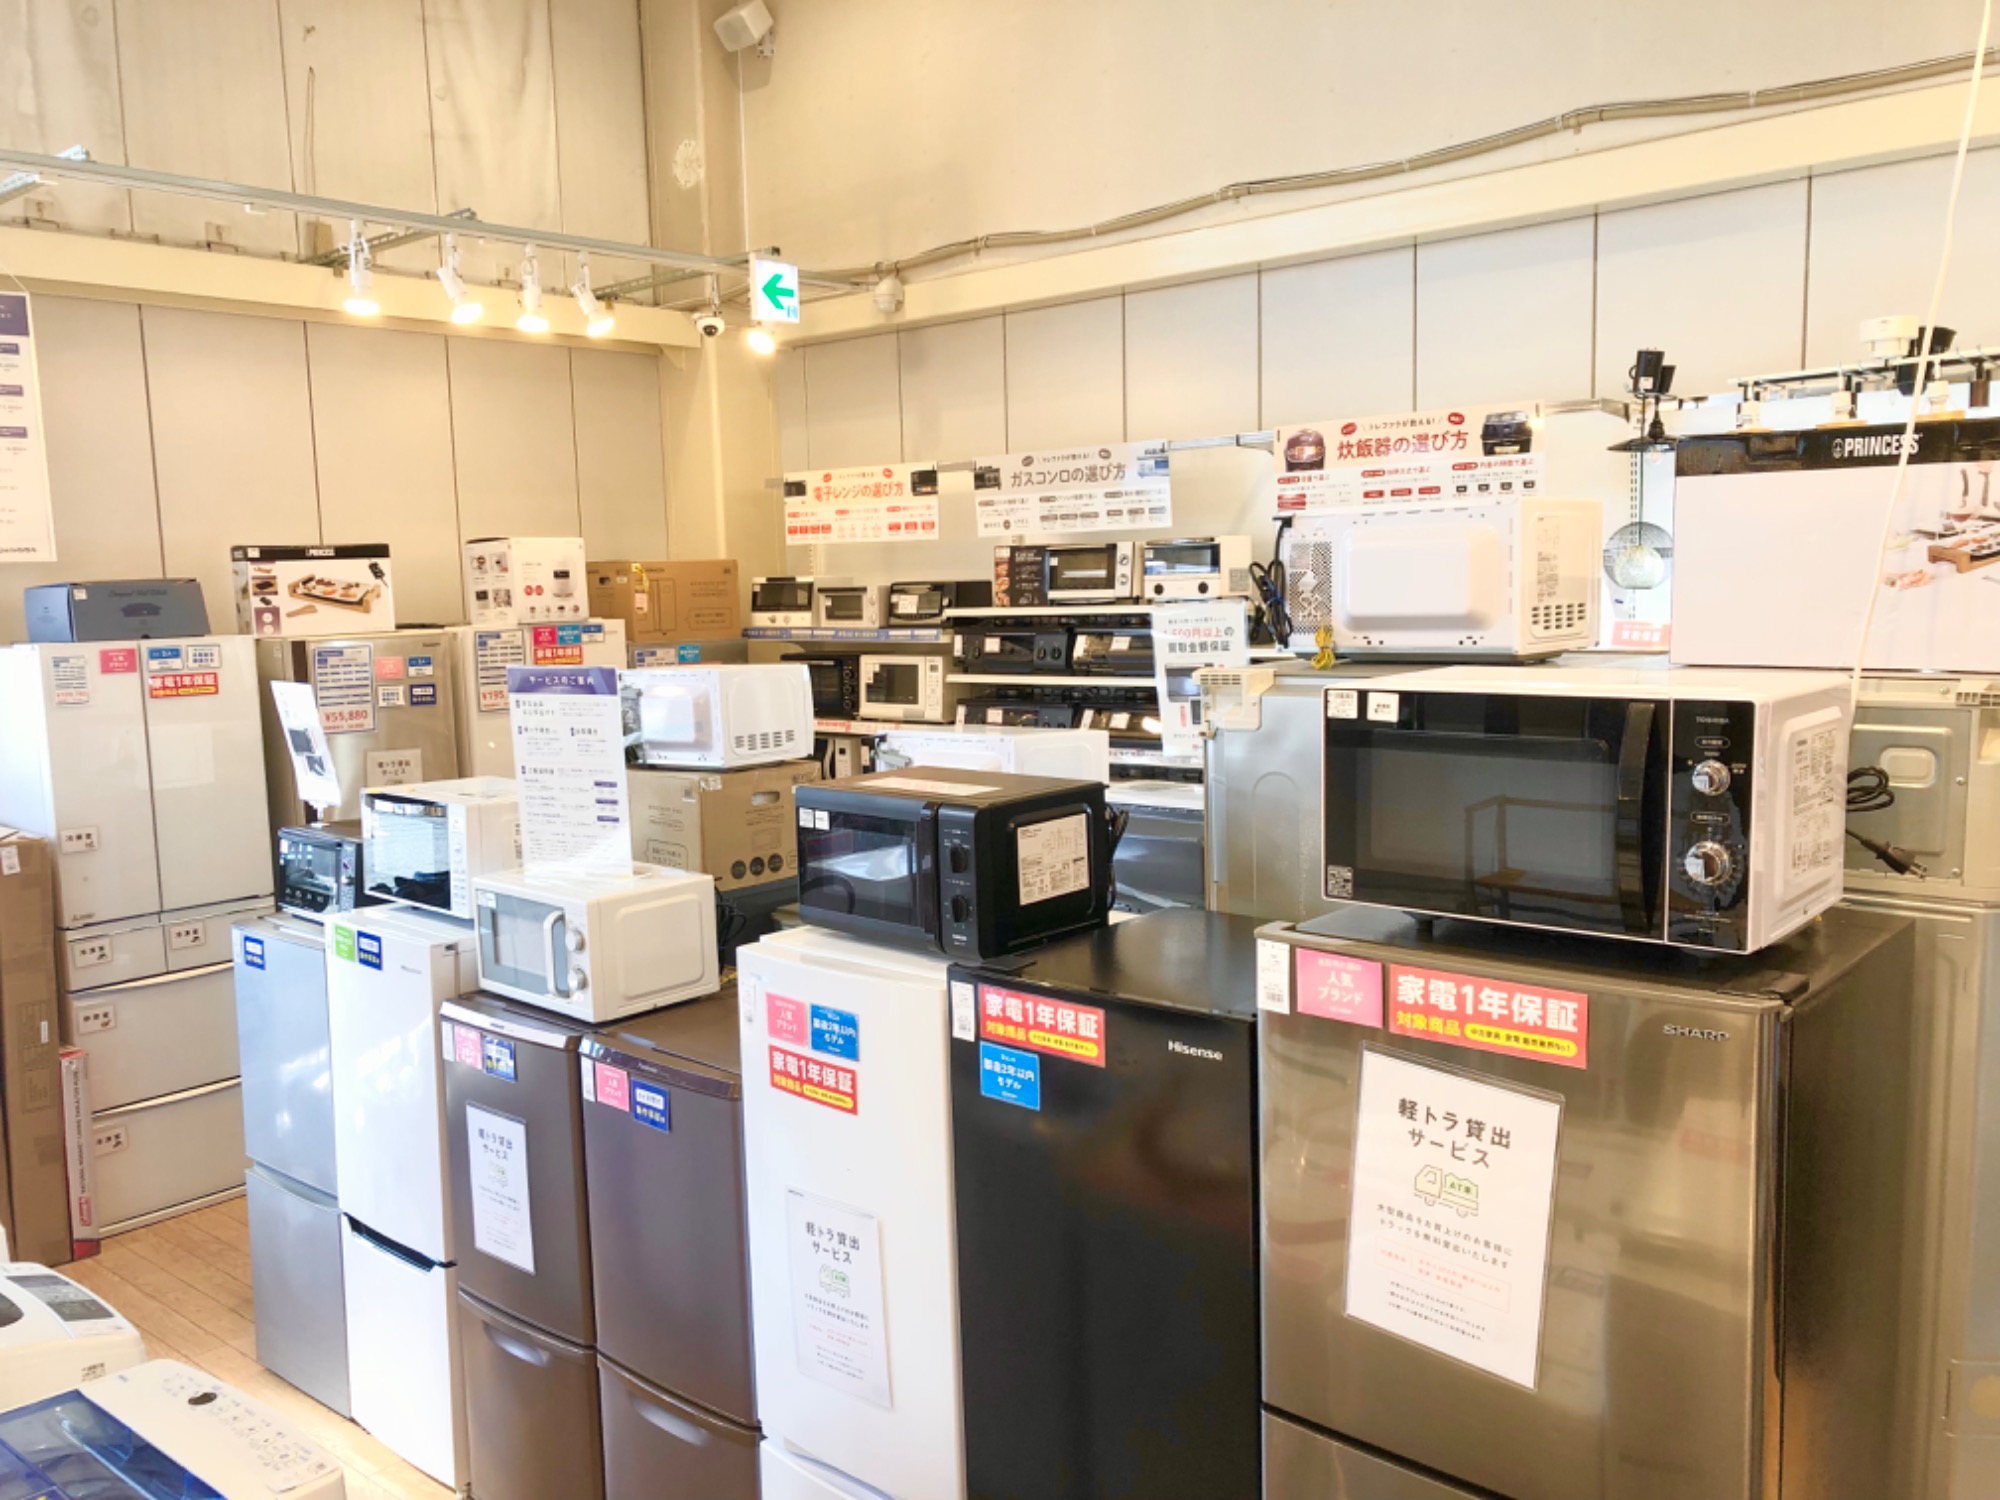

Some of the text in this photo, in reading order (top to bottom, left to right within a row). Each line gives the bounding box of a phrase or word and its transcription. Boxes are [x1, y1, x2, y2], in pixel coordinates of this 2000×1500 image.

[1337, 430, 1469, 460] 炊飯器の選び方
[1844, 433, 1919, 458] PRINCESS
[1011, 463, 1126, 488] ガスコンロの選び方
[813, 482, 904, 502] 電子レンジの選び方
[1168, 640, 1231, 653] 買取金額保証
[528, 675, 595, 686] サービスのご案内
[1326, 971, 1354, 988] 人気
[1318, 986, 1364, 1006] ブランド
[1397, 974, 1578, 1032] 家電1年保証
[985, 993, 1098, 1038] 家電1年保証
[1396, 1010, 1461, 1037] 対象商品
[824, 1034, 845, 1045] モデル
[985, 1019, 1027, 1042] 対象商品
[1663, 1023, 1729, 1041] SHARP
[1168, 1039, 1223, 1061] Hisense
[772, 1050, 854, 1094] 家電1年保証
[997, 1076, 1022, 1090] モデル
[1397, 1097, 1512, 1150] 軽トラ貸出
[1408, 1127, 1490, 1169] サービス
[1449, 1181, 1472, 1194] AT車
[805, 1220, 861, 1252] 軽トラ貸出
[812, 1240, 852, 1265] サービス
